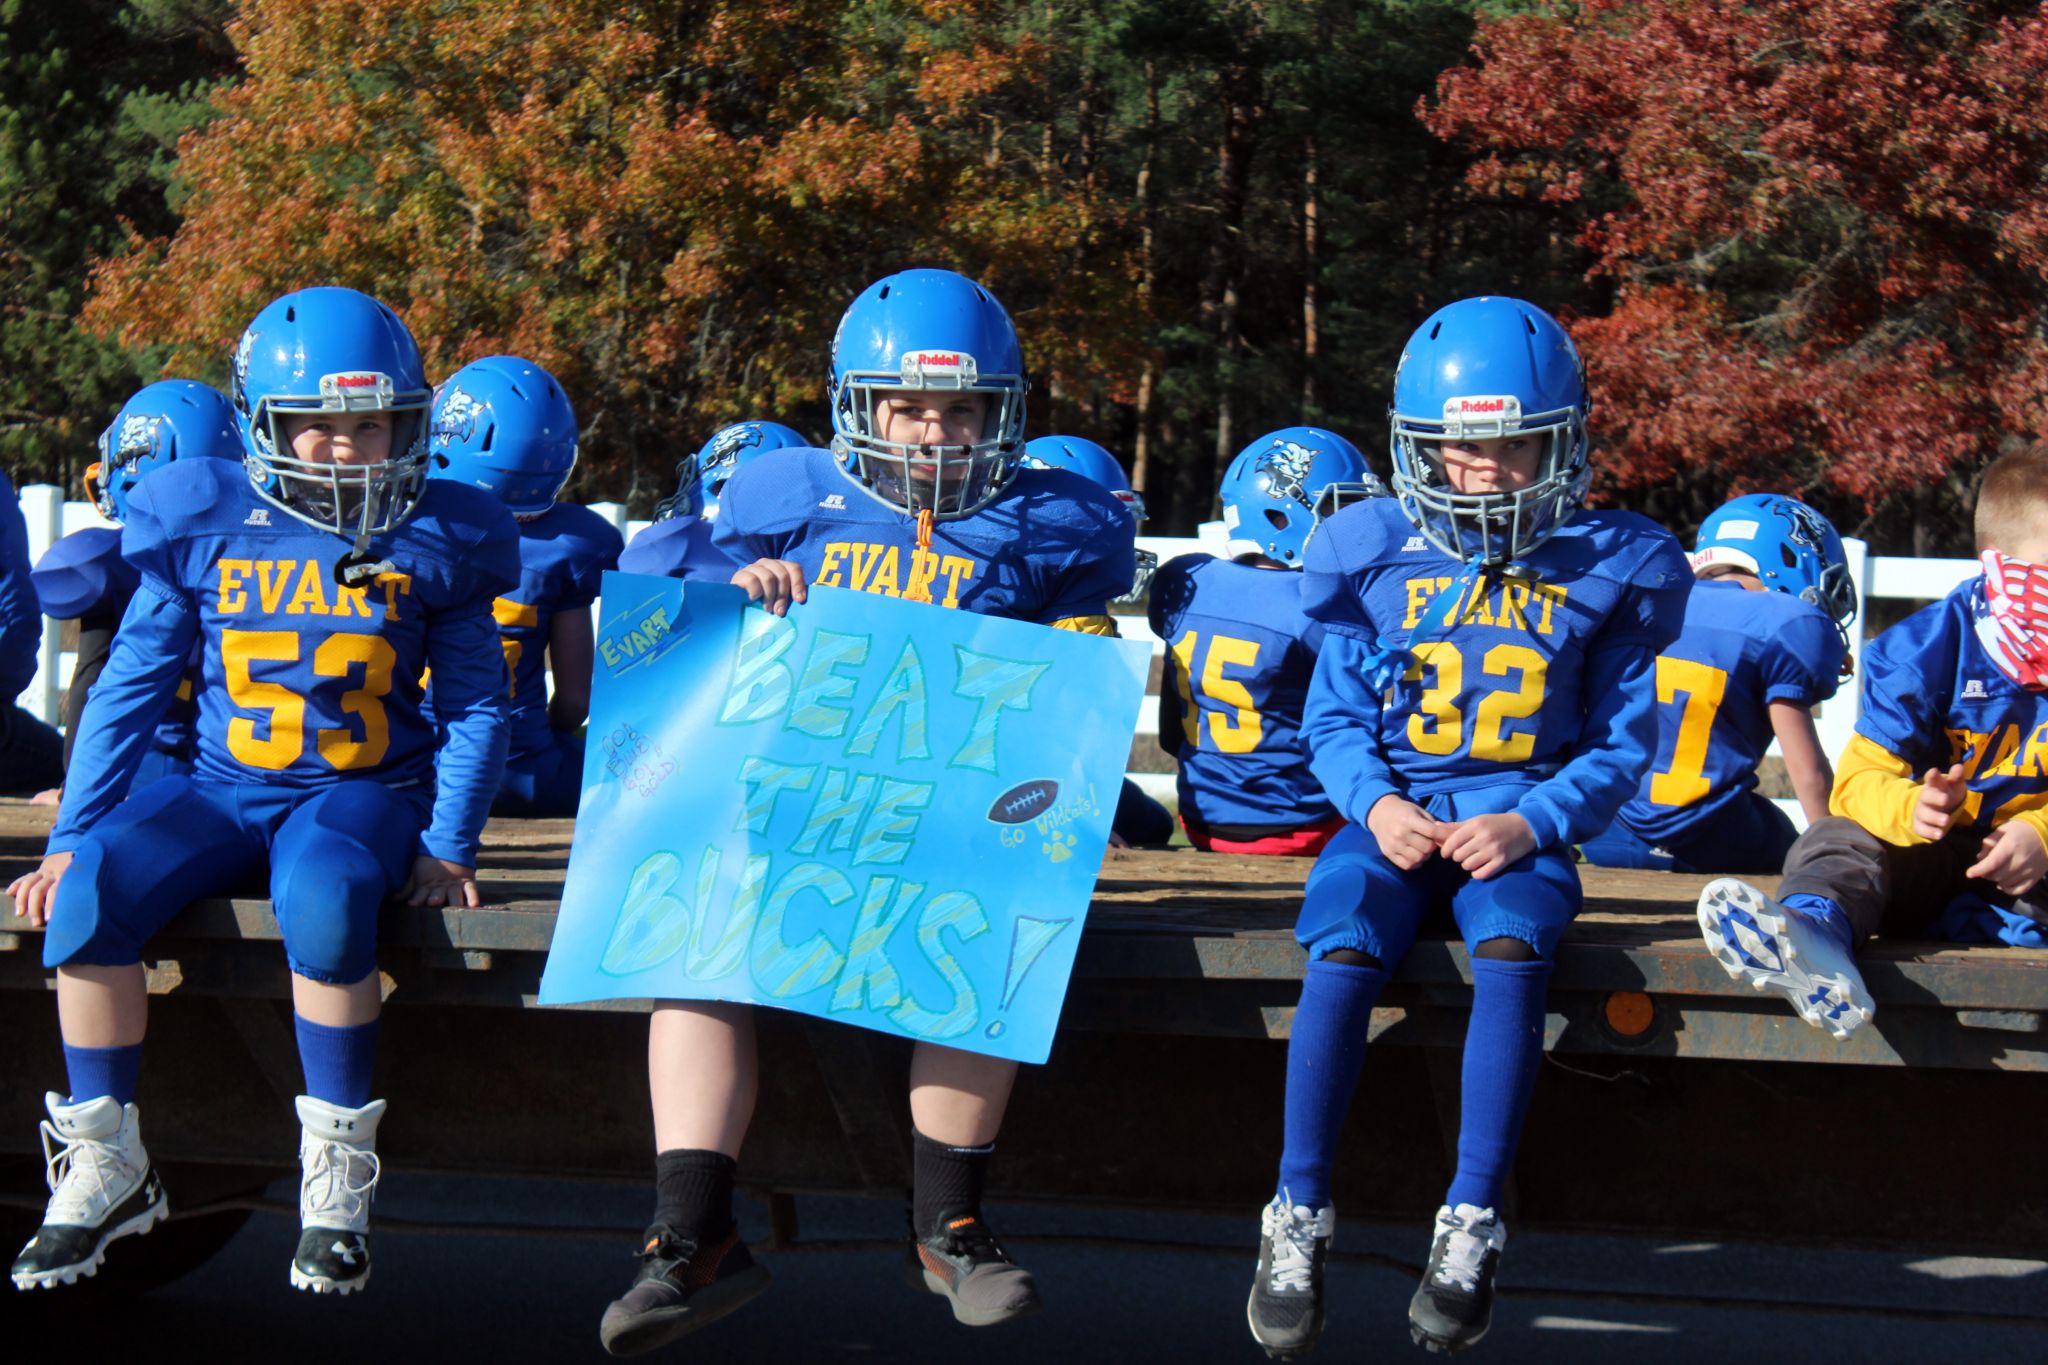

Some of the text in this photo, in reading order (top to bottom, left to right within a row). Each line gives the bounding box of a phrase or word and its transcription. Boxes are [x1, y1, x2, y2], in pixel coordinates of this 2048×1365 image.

[918, 353, 960, 366] Riddell
[1460, 399, 1504, 412] Riddell
[216, 558, 412, 621] EVART
[813, 542, 975, 609] EVART
[599, 606, 671, 668] EVART
[221, 628, 396, 771] 53
[715, 603, 1053, 777] BEAT
[1171, 630, 1263, 754] 15
[1402, 641, 1549, 763] 32
[732, 754, 936, 866] THE
